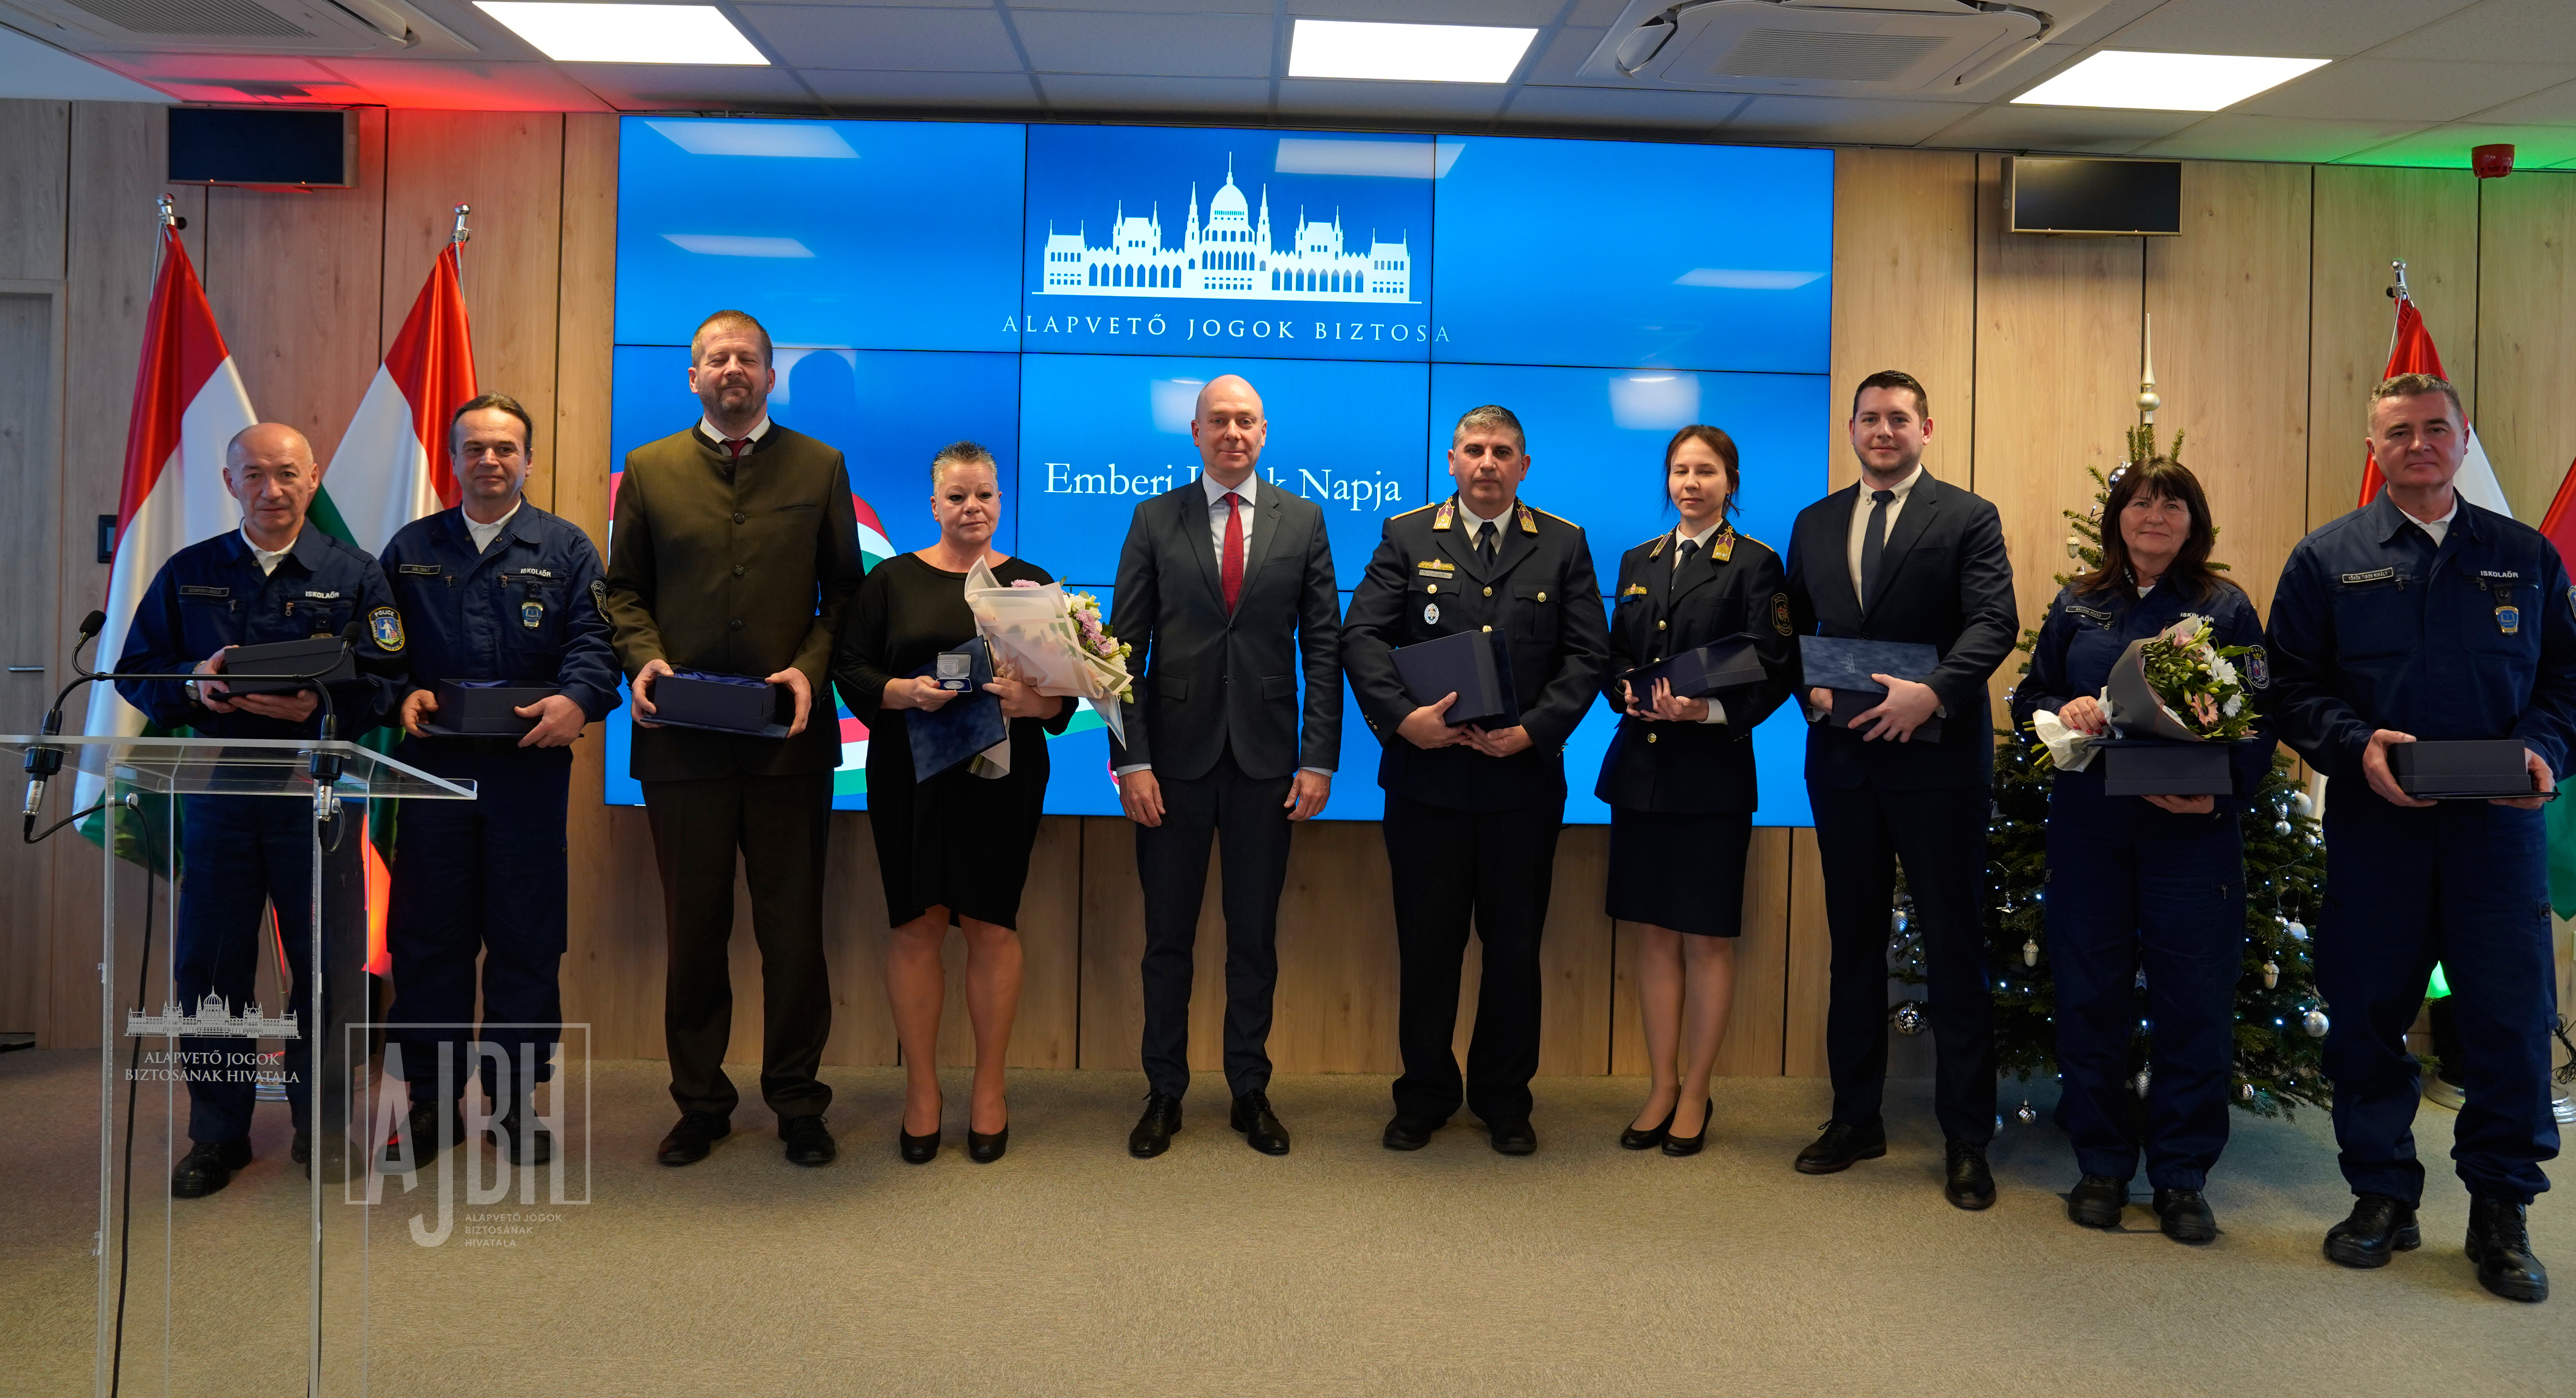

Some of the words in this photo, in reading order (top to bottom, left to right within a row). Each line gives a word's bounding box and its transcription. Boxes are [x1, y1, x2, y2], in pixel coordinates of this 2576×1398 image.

[1002, 313, 1167, 335] ALAPVETŐ
[1186, 319, 1295, 340] JOGOK
[1315, 322, 1451, 343] BIZTOSA
[1044, 462, 1173, 496] Emberi
[1298, 468, 1402, 512] Napja
[520, 568, 551, 577] ISKOLAŐR
[143, 1050, 225, 1065] ALAPVETŐ
[226, 1053, 281, 1068] JOGOK
[125, 1066, 224, 1082] BIZTOSÁNAK
[226, 1070, 301, 1083] HIVATALA
